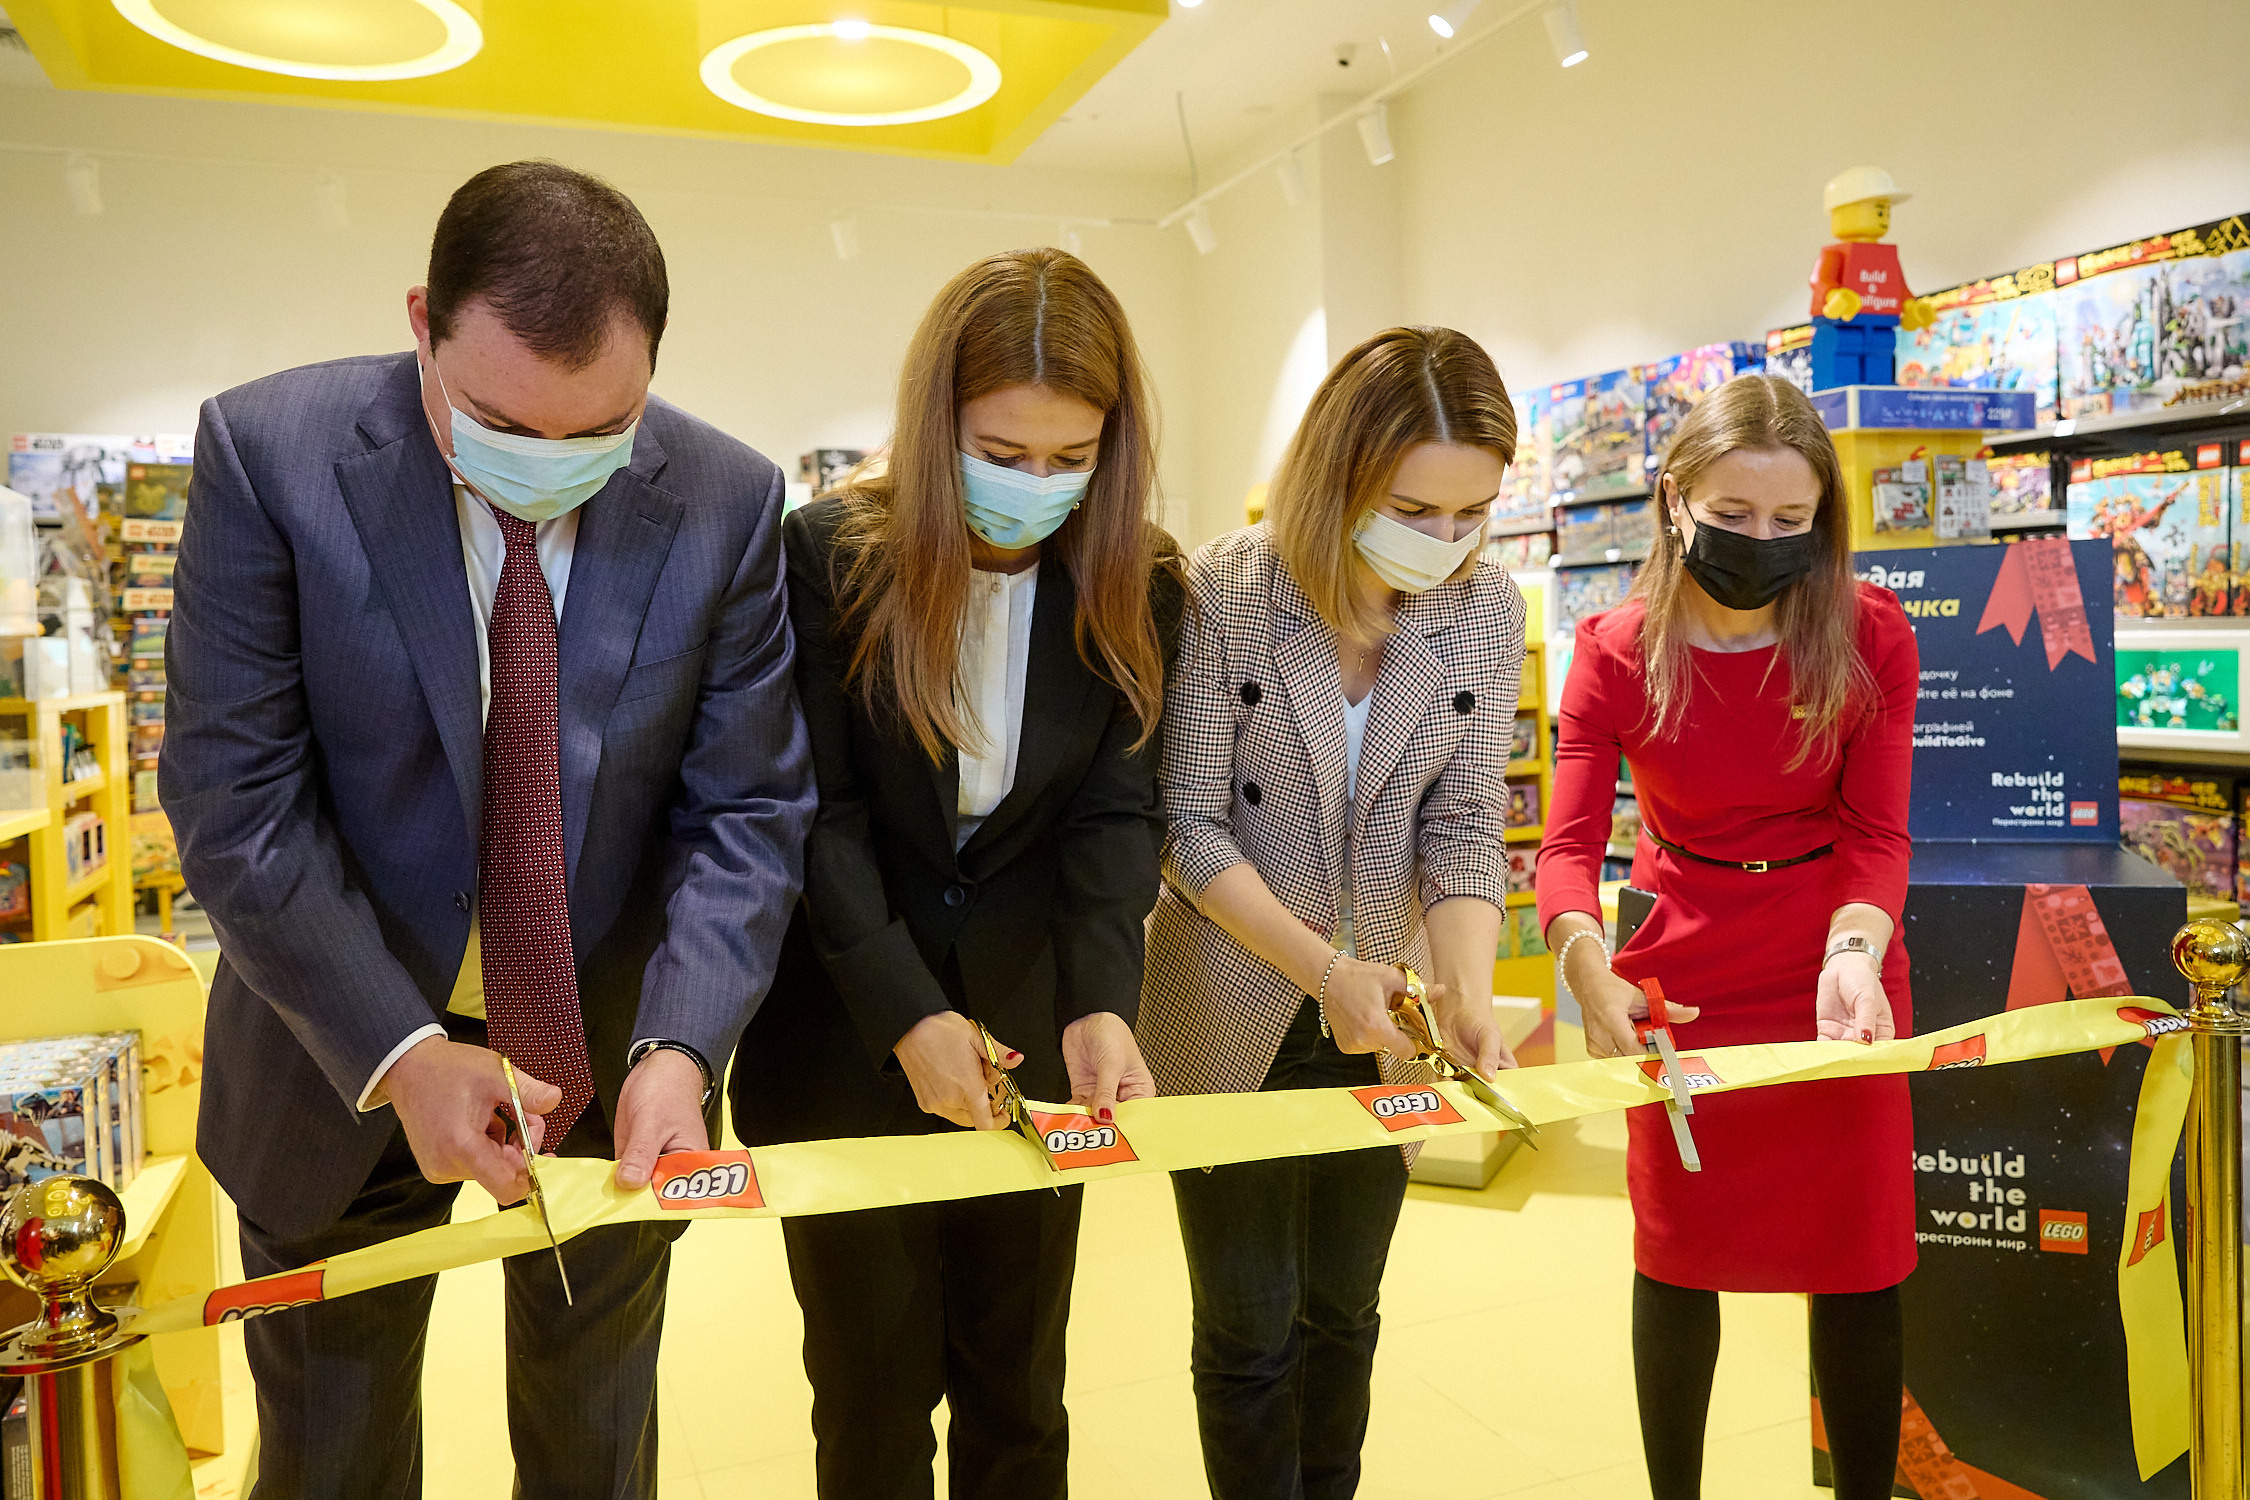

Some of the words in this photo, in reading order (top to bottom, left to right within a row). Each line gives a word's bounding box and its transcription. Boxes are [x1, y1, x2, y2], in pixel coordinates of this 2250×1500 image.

[1860, 269, 1887, 283] Build
[1868, 284, 1877, 294] a
[1901, 599, 1960, 618] чка
[1919, 670, 1959, 682] дочку
[1917, 687, 1939, 699] йте
[1942, 687, 1959, 699] её
[1961, 690, 1977, 699] на
[1979, 688, 2014, 700] фоне
[1913, 721, 1975, 735] ографией
[1992, 771, 2064, 787] Rebuild
[2031, 786, 2065, 802] the
[2009, 802, 2065, 817] world
[2072, 808, 2097, 819] LEGO
[1373, 1091, 1440, 1117] LEGO
[1045, 1127, 1116, 1153] LEGO
[661, 1163, 750, 1200] LEGO
[1969, 1178, 2027, 1206] the
[1930, 1206, 2026, 1233] world
[2043, 1223, 2085, 1241] LEGO
[1996, 1239, 2027, 1252] мир
